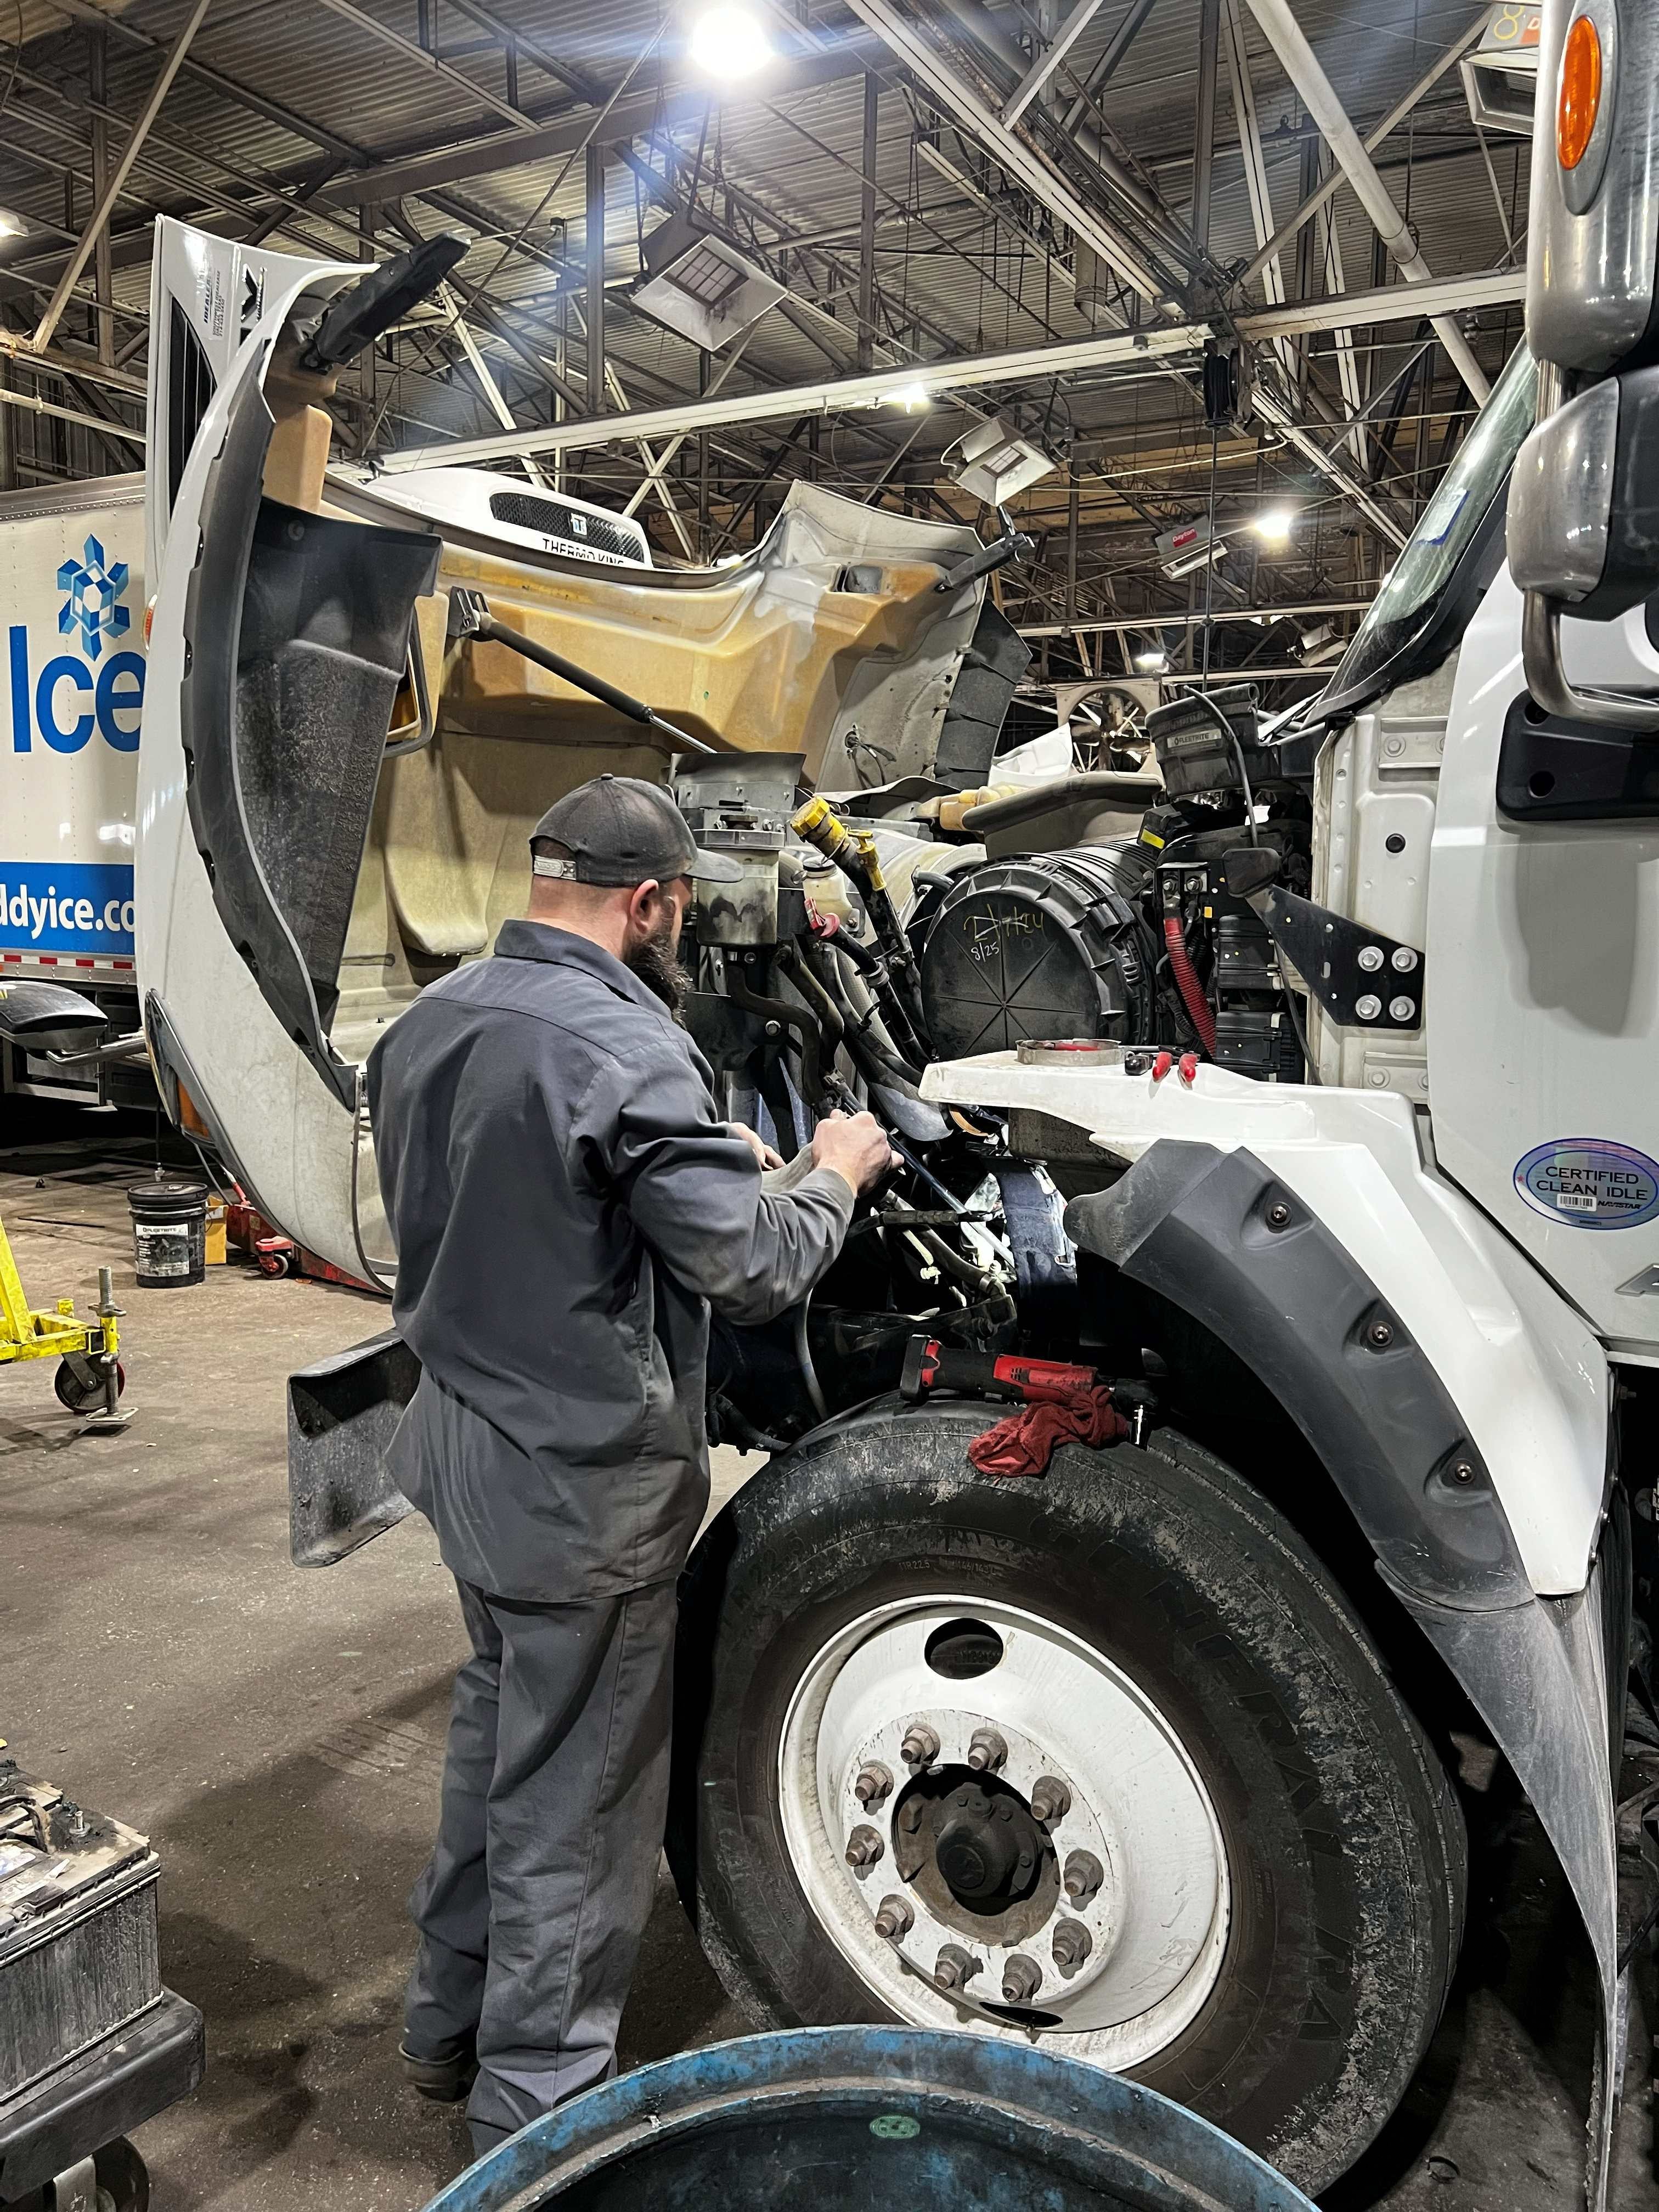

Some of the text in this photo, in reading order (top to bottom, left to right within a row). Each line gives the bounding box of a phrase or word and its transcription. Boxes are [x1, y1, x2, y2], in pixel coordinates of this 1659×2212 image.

[1172, 528, 1195, 543] Dayton
[9, 625, 146, 753] Ice
[1180, 732, 1210, 743] FLEETRITE
[970, 941, 999, 962] 8/25
[1545, 1166, 1639, 1184] CERTIFIED
[1536, 1180, 1648, 1200] CLEAN IDLE
[1597, 1200, 1642, 1210] NAVISTAR
